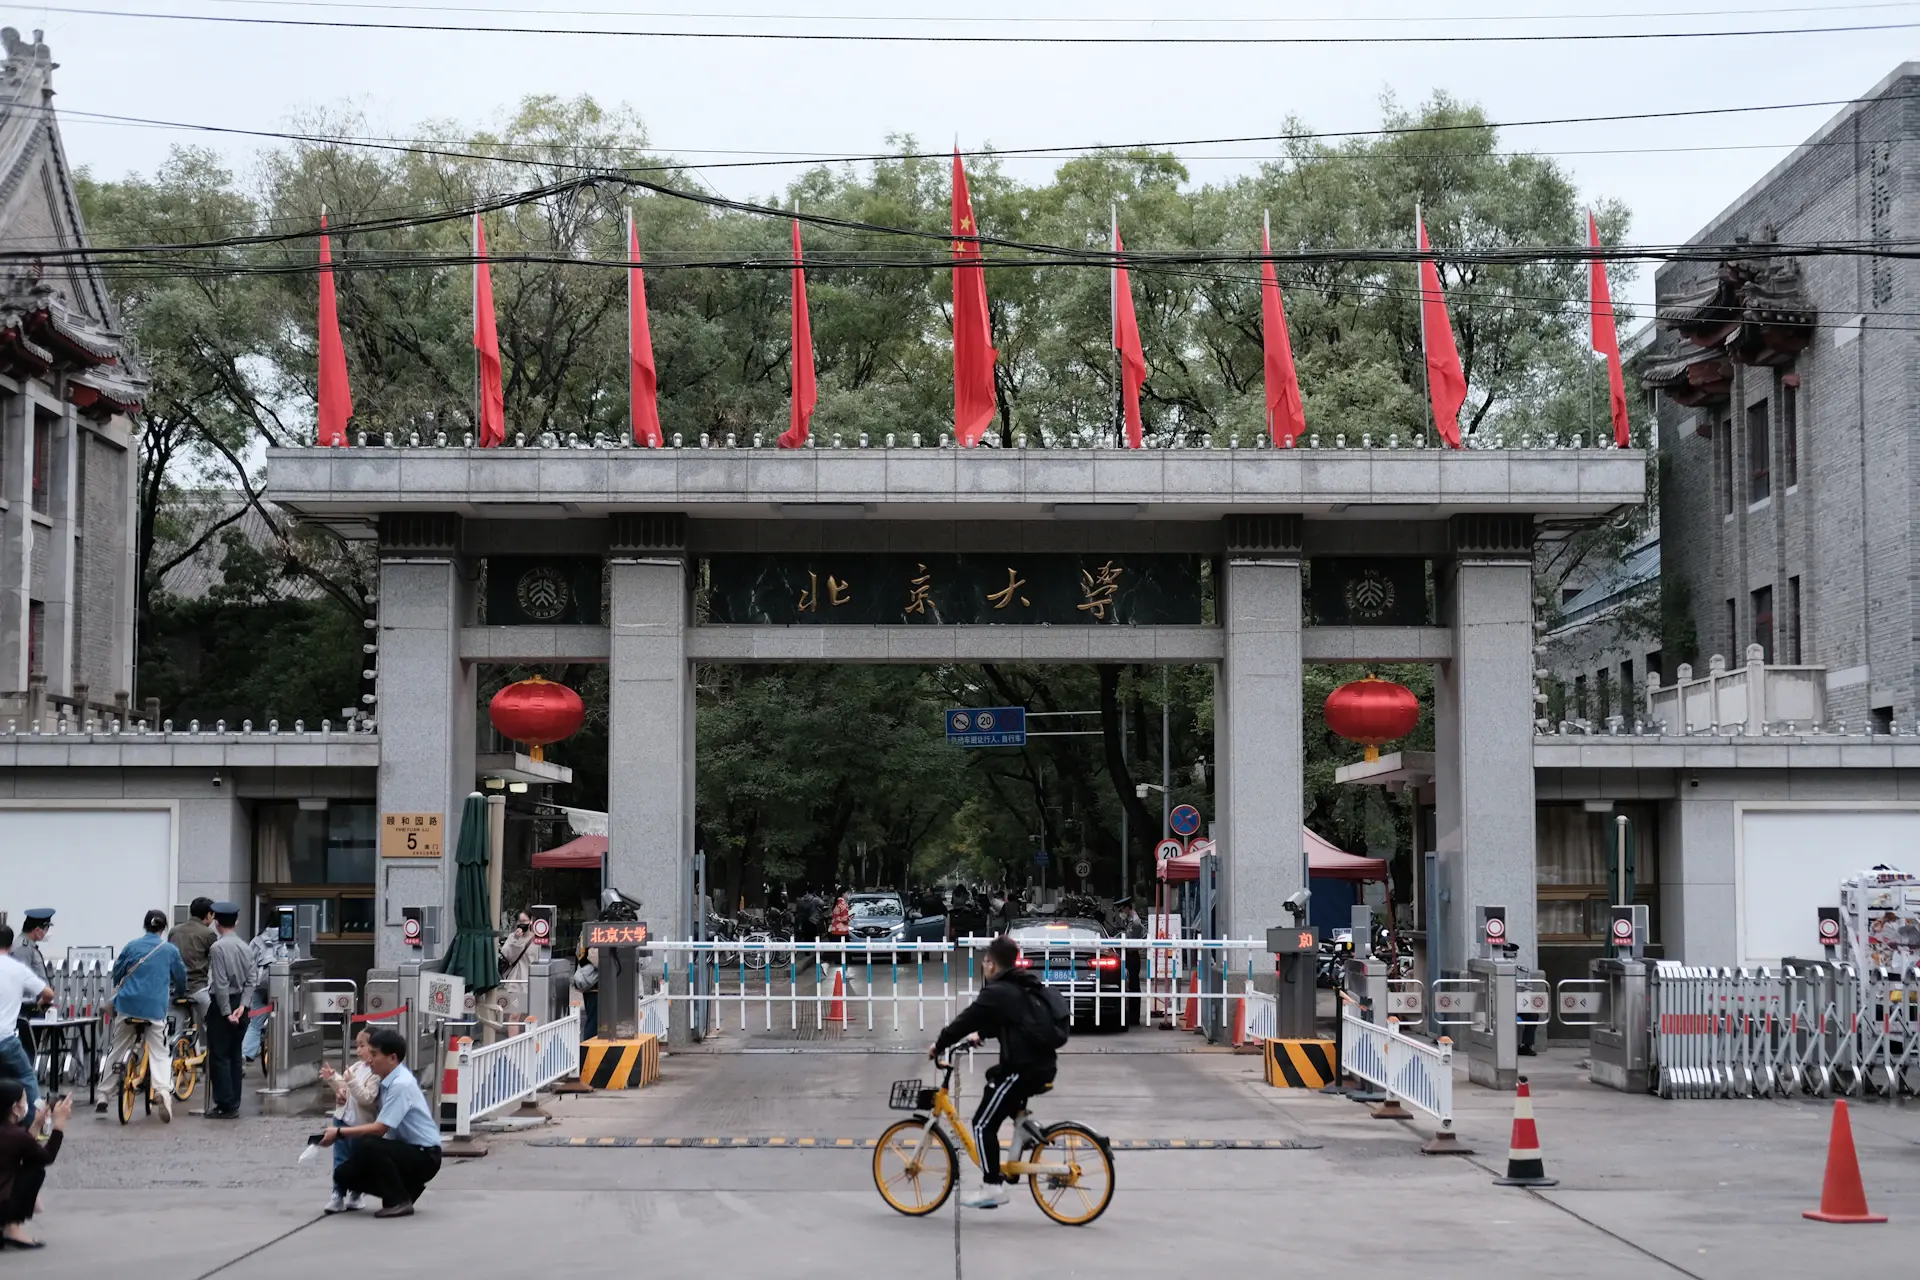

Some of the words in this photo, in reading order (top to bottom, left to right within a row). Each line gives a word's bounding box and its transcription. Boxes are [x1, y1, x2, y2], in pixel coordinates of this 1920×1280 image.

[980, 716, 991, 726] 20
[386, 816, 438, 826] 颐和园路
[407, 832, 418, 850] 5
[1163, 846, 1178, 860] 20
[1078, 865, 1088, 874] 20
[590, 926, 646, 943] 北京大学
